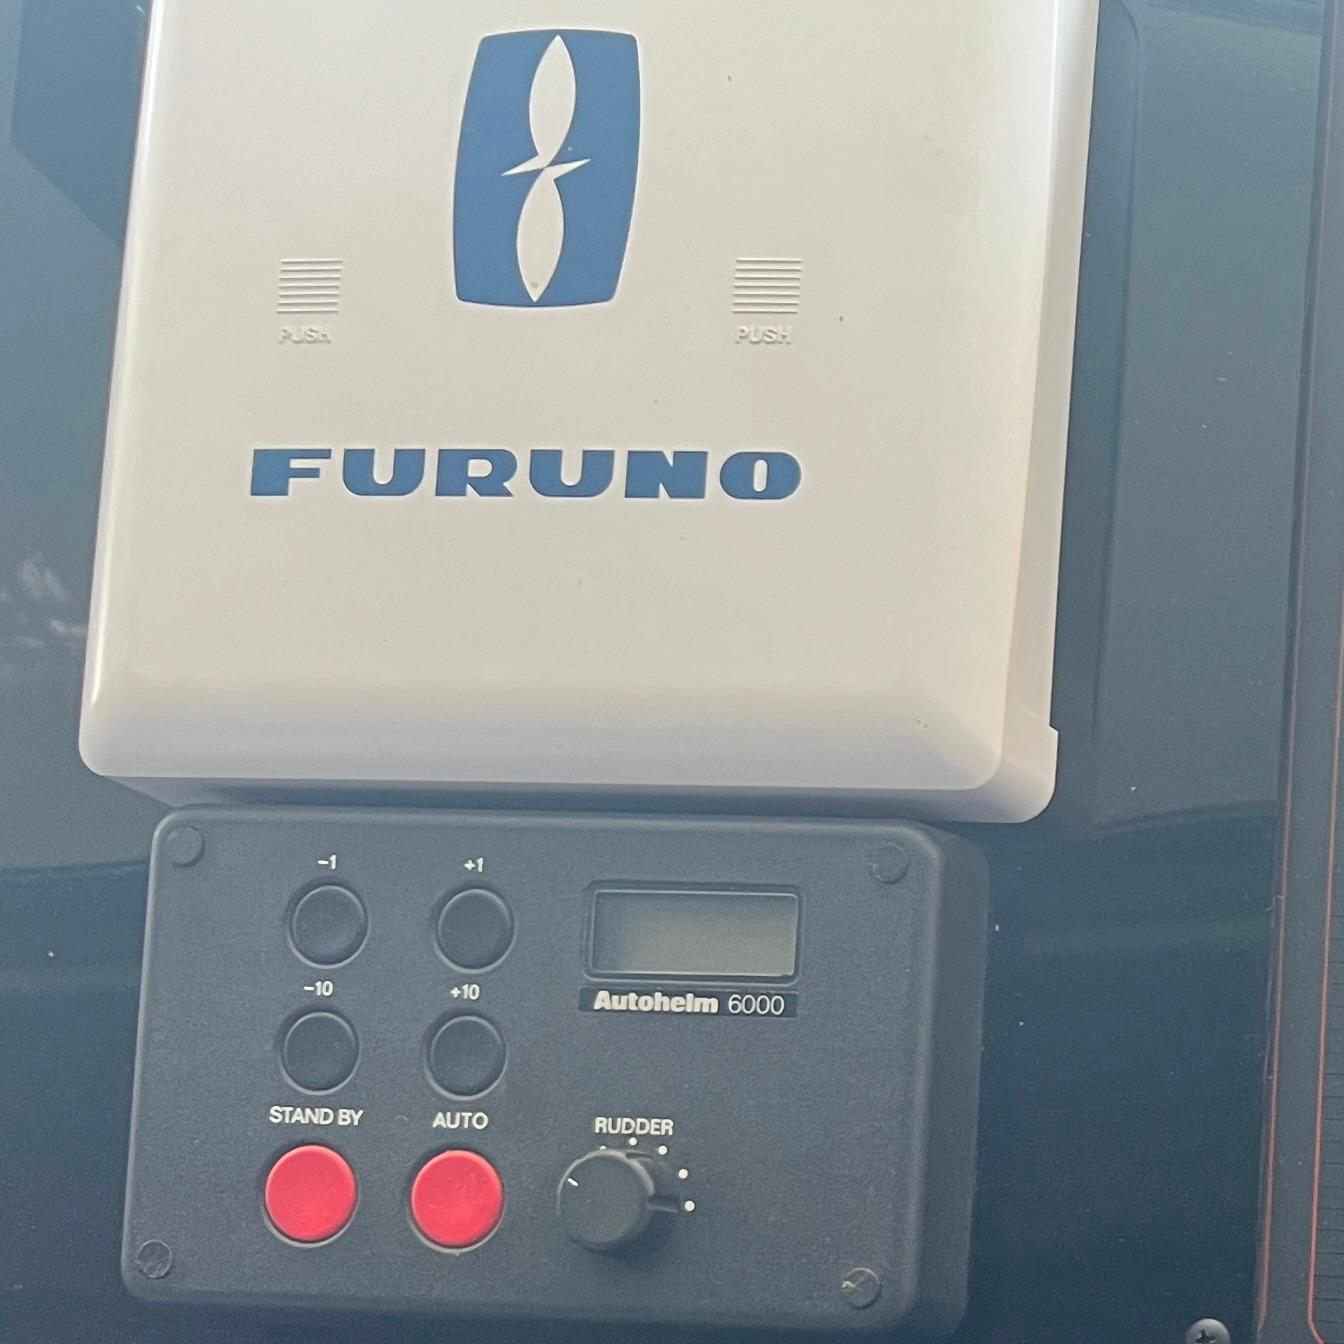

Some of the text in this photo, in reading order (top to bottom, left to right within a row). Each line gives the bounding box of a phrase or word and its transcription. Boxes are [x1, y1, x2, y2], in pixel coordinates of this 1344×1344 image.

[278, 326, 332, 345] PUSH
[734, 325, 793, 345] PUSH
[249, 447, 803, 500] FURUNO
[593, 990, 786, 1016] Autohelm 6000
[269, 1106, 364, 1127] STAND BY
[432, 1111, 489, 1131] AUTO
[594, 1116, 674, 1137] RUDDER
